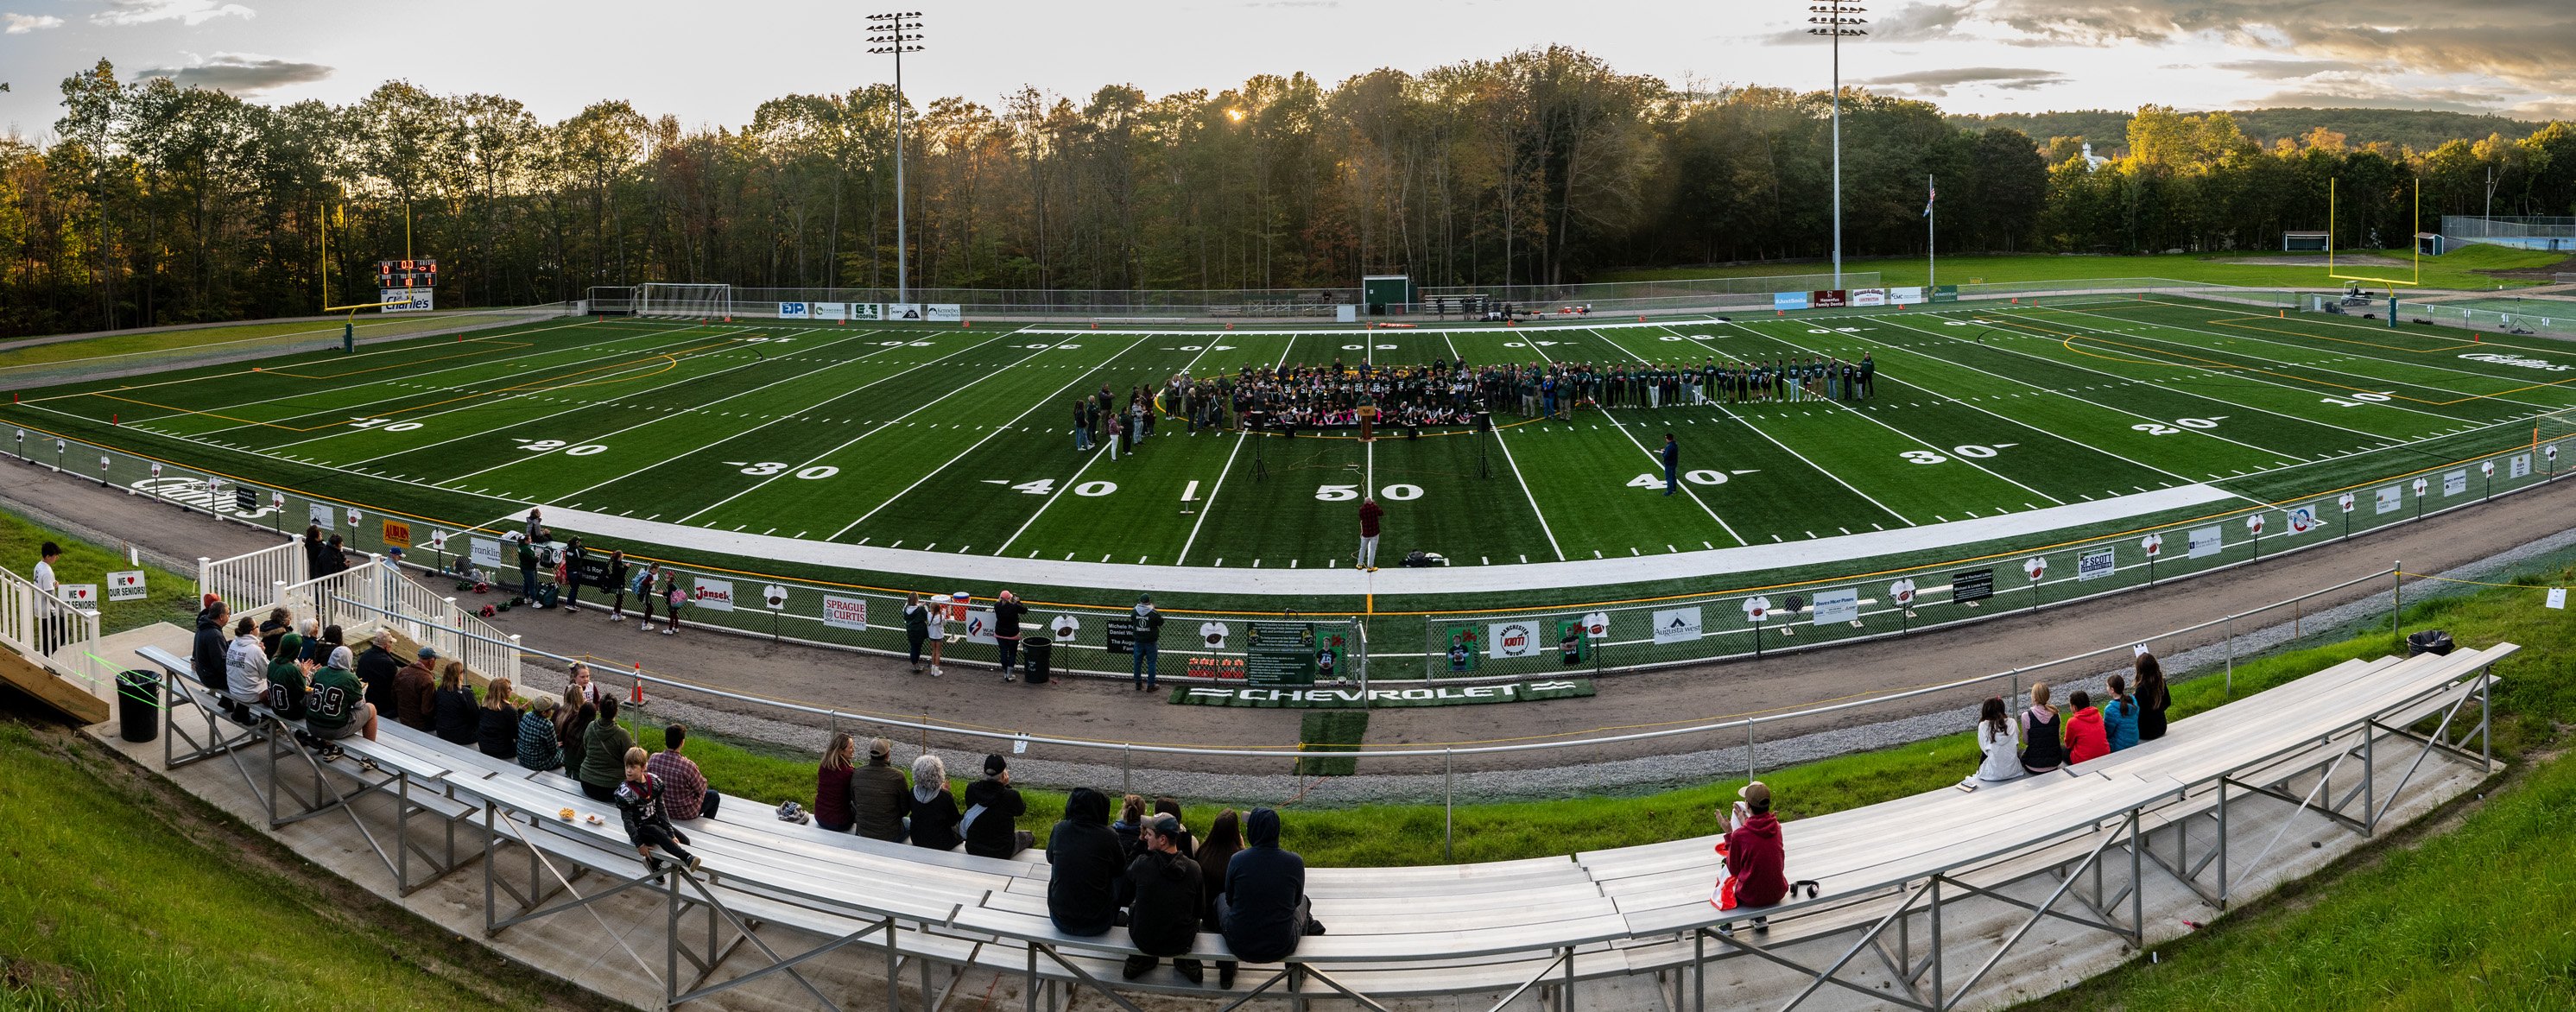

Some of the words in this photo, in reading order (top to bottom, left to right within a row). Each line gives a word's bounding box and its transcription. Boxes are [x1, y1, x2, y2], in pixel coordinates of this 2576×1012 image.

[383, 265, 389, 274] 0
[385, 522, 409, 539] AUBURN
[471, 543, 500, 558] Franklin
[2080, 559, 2089, 567] JF
[2090, 553, 2111, 565] SCOTT
[2081, 563, 2111, 572] CONSTRUCTION
[117, 577, 126, 585] WE
[68, 590, 77, 598] WE
[109, 588, 121, 597] OUR
[122, 585, 145, 597] SENIORS!
[72, 600, 97, 610] SENIORS!
[826, 599, 864, 612] SPRAGUE
[834, 610, 864, 622] CURTIS
[1500, 624, 1529, 636] MANCHESTER
[1655, 627, 1683, 637] Augusta
[1239, 683, 1521, 702] CHEVROLET
[310, 683, 345, 717] 69
